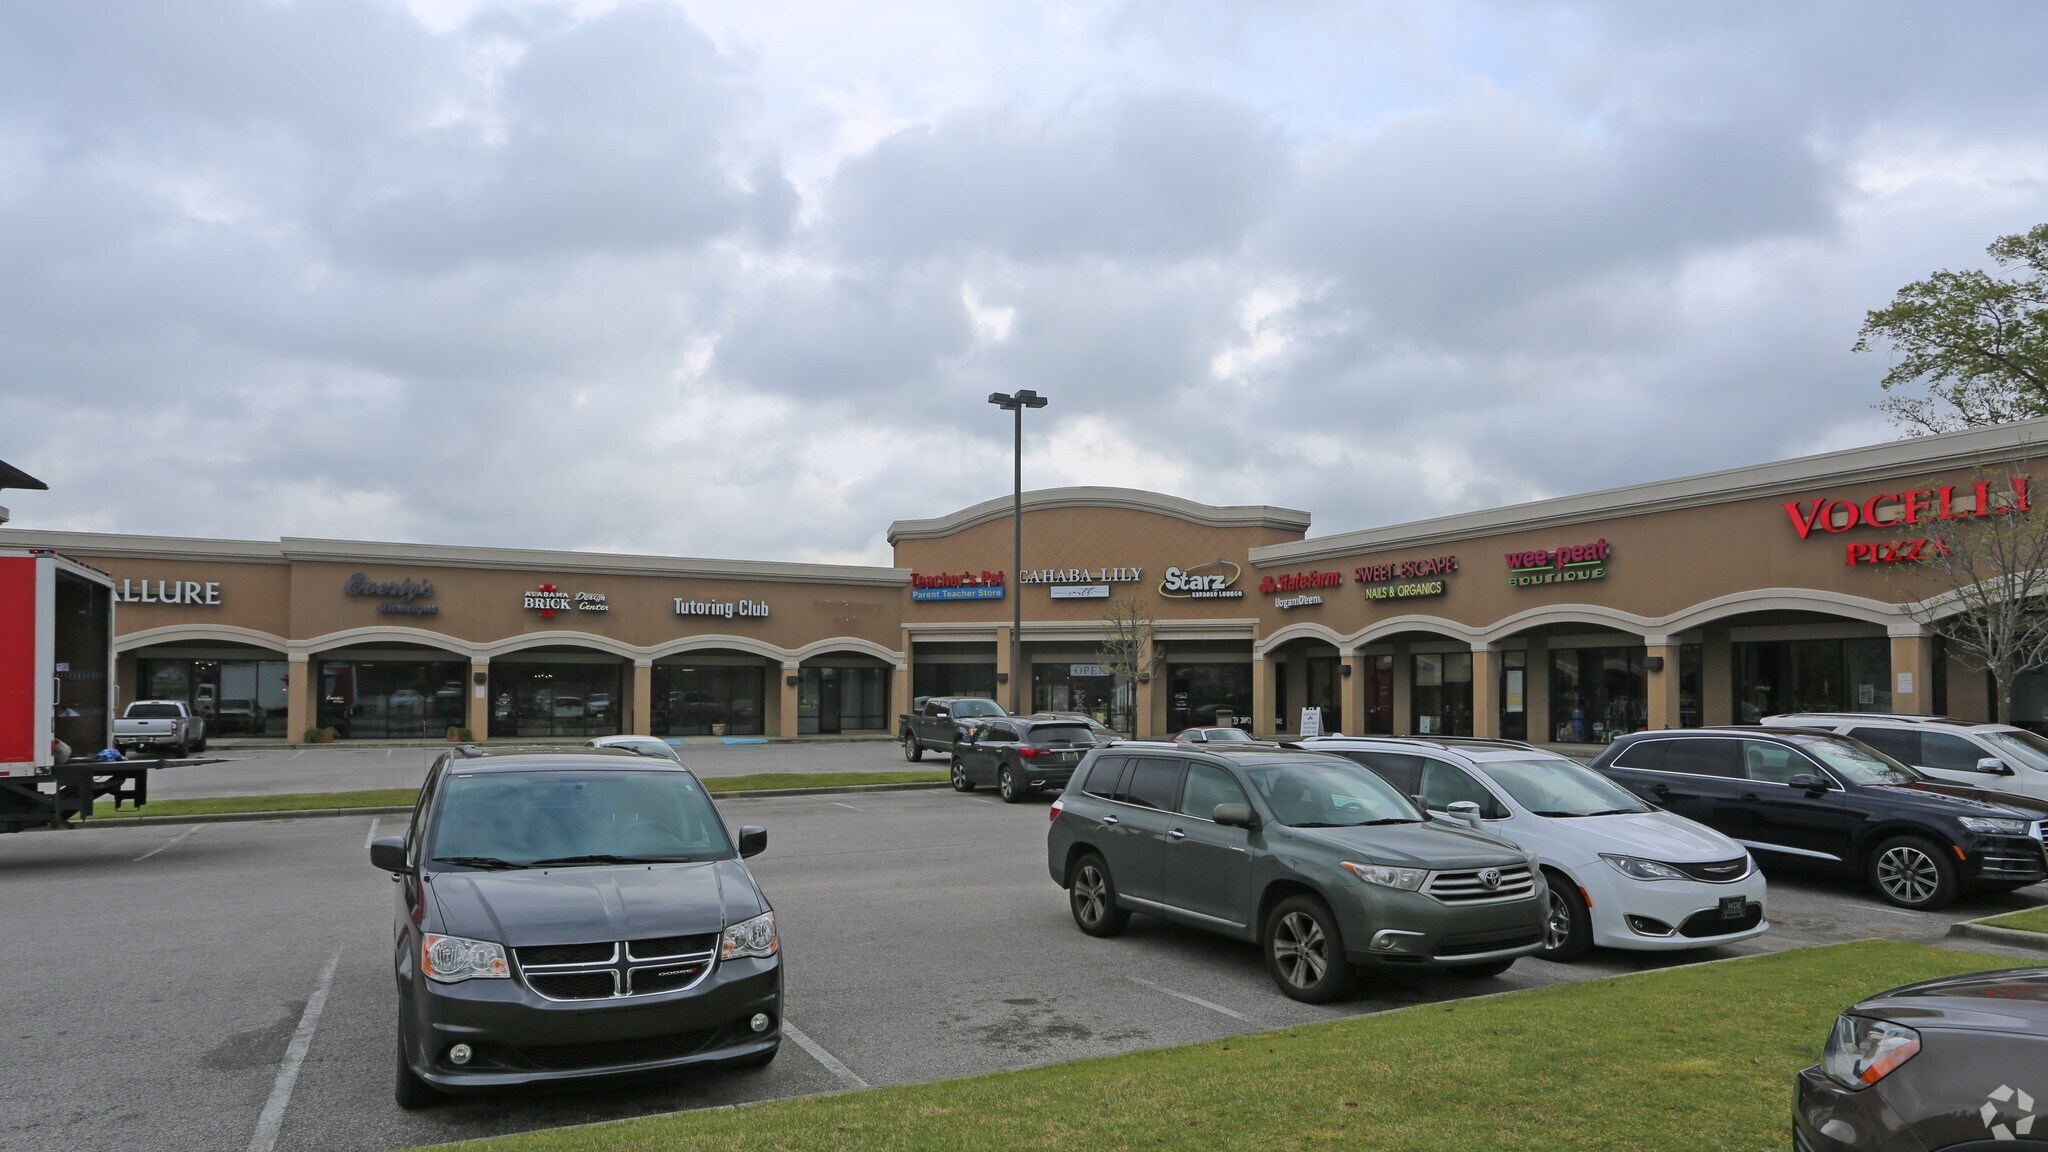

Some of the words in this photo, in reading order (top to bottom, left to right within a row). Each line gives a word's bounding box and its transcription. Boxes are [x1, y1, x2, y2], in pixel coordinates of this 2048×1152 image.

[1504, 538, 1607, 570] wee-peat
[1019, 568, 1093, 584] CAHABA
[1100, 567, 1143, 582] LILY
[1165, 566, 1225, 590] Starz
[1354, 563, 1395, 583] SWEET
[1400, 556, 1455, 578] ESCAPE
[1509, 568, 1606, 587] BOUTIQUE
[910, 571, 977, 588] Teacher's
[981, 570, 1004, 586] Pet
[574, 592, 606, 602] Design
[912, 591, 939, 599] Parent
[942, 589, 976, 598] Teacher
[978, 588, 1001, 597] Store
[1365, 587, 1387, 599] NAILS
[1389, 586, 1395, 597] &
[1397, 581, 1442, 597] ORGANICS
[523, 597, 571, 610] BRICK
[578, 601, 609, 611] Center
[673, 597, 734, 619] Tutoring
[738, 599, 769, 617] Club
